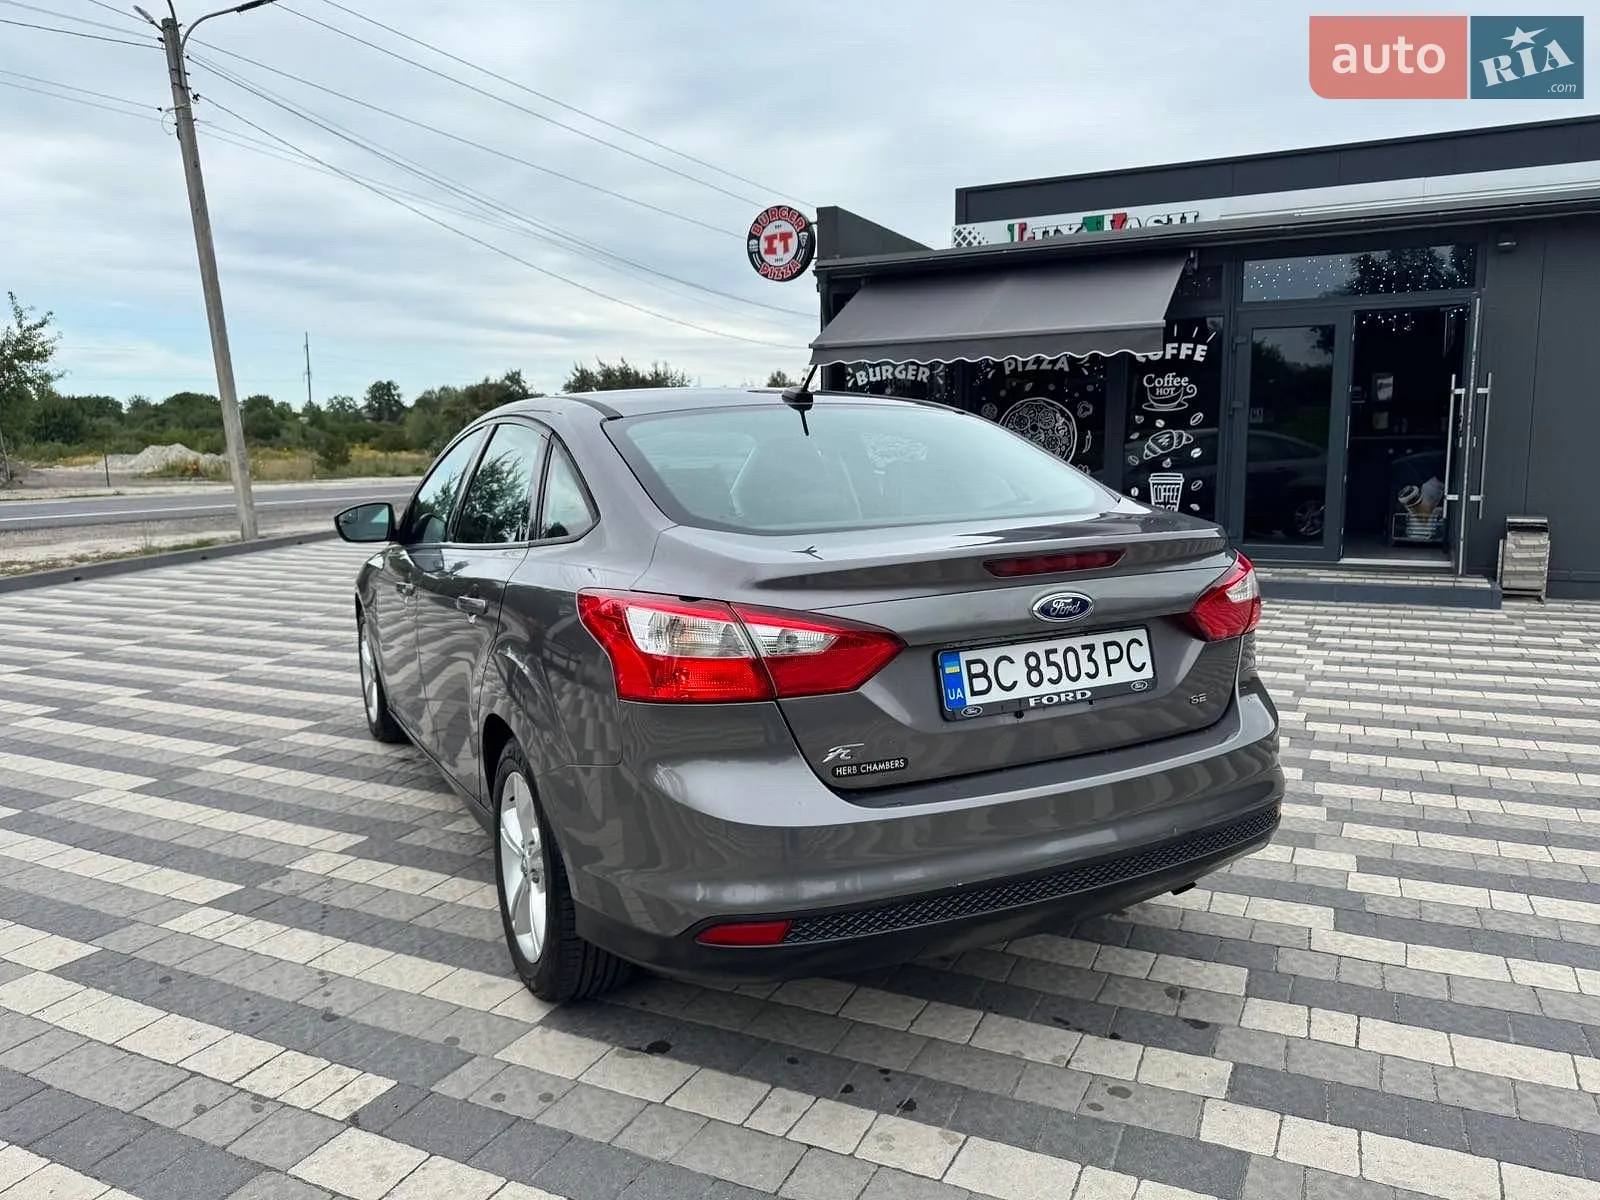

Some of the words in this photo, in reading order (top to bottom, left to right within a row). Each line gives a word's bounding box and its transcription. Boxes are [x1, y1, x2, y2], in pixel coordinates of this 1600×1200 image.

[751, 207, 806, 237] BURGER
[764, 231, 794, 256] IT
[760, 259, 801, 280] PIZZA
[855, 364, 931, 386] BURGER
[1003, 355, 1070, 376] PIZZA
[1143, 372, 1189, 387] Coffee
[1155, 388, 1176, 396] HOT
[1049, 598, 1082, 617] Ford
[965, 654, 1018, 698] BC
[1023, 643, 1100, 688] 8503
[1103, 637, 1147, 677] PC
[947, 688, 964, 700] UA
[1029, 690, 1093, 707] FORD
[1190, 693, 1207, 704] SE
[836, 766, 858, 776] HERB
[860, 758, 905, 773] CHAMBERS
